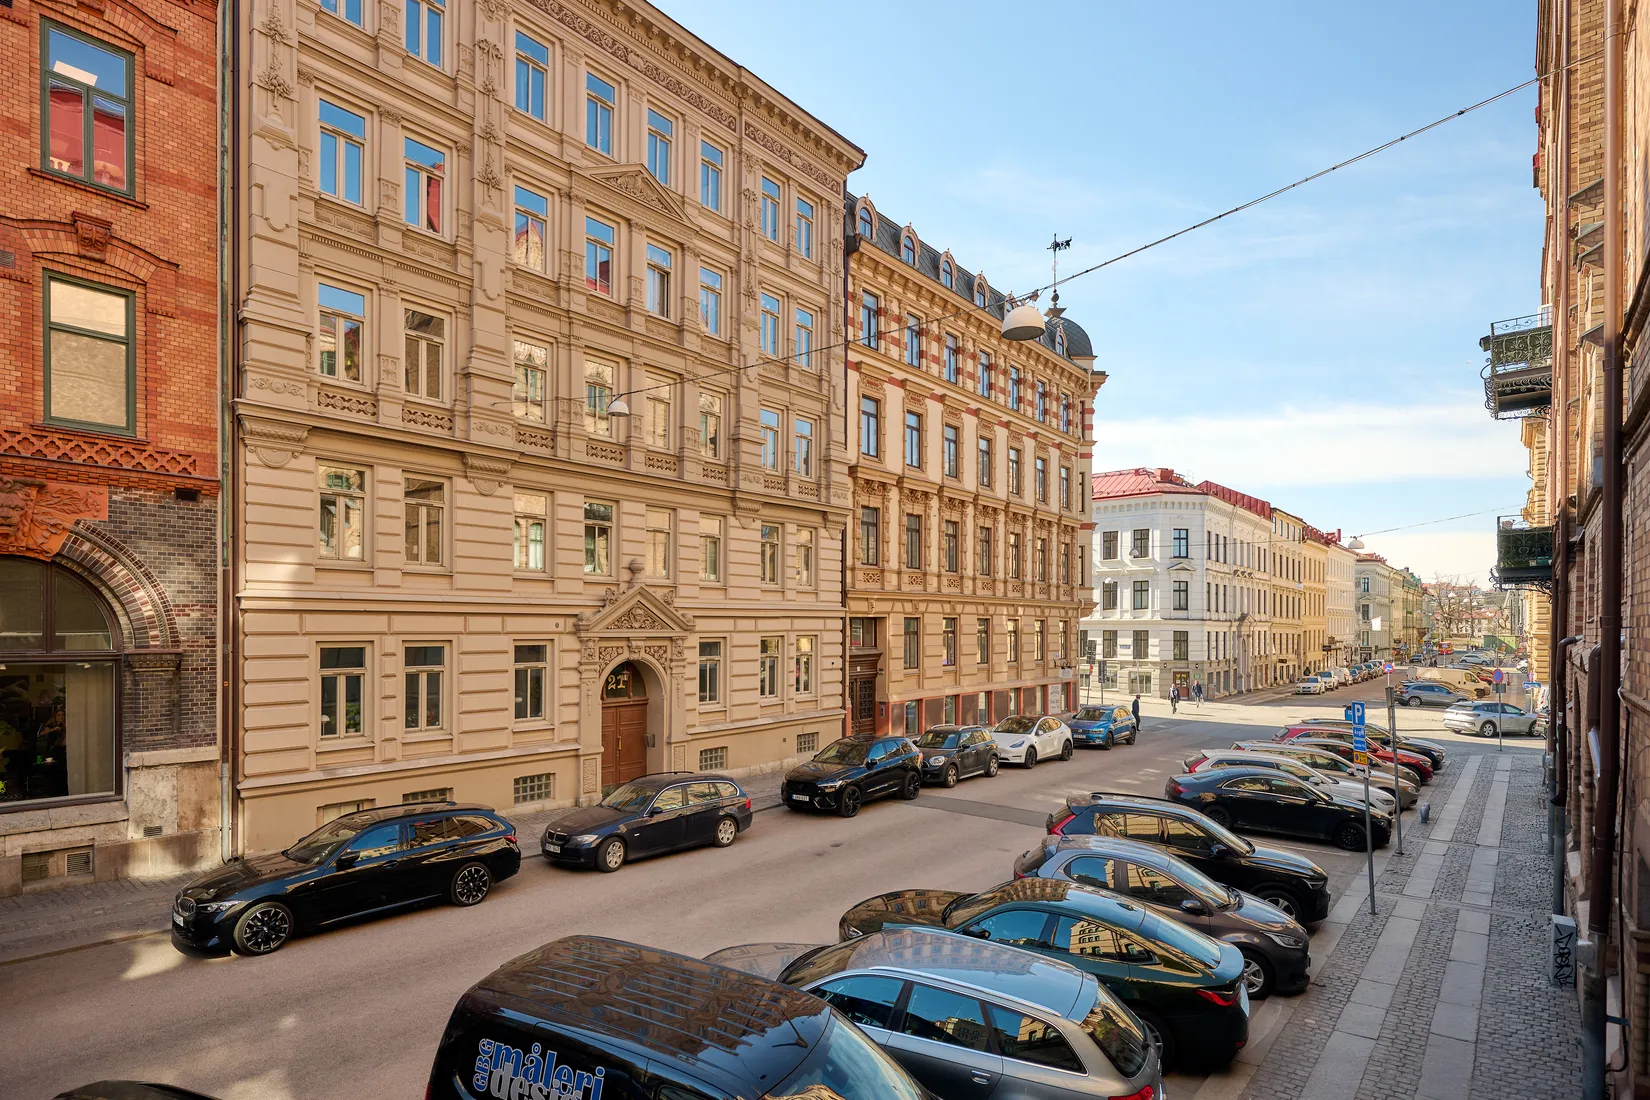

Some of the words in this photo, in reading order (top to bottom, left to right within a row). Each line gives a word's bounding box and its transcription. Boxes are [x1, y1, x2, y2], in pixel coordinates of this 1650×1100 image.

[608, 675, 625, 689] 21
[1354, 704, 1362, 723] P
[473, 1038, 495, 1092] GBG
[490, 1041, 605, 1100] måleri
